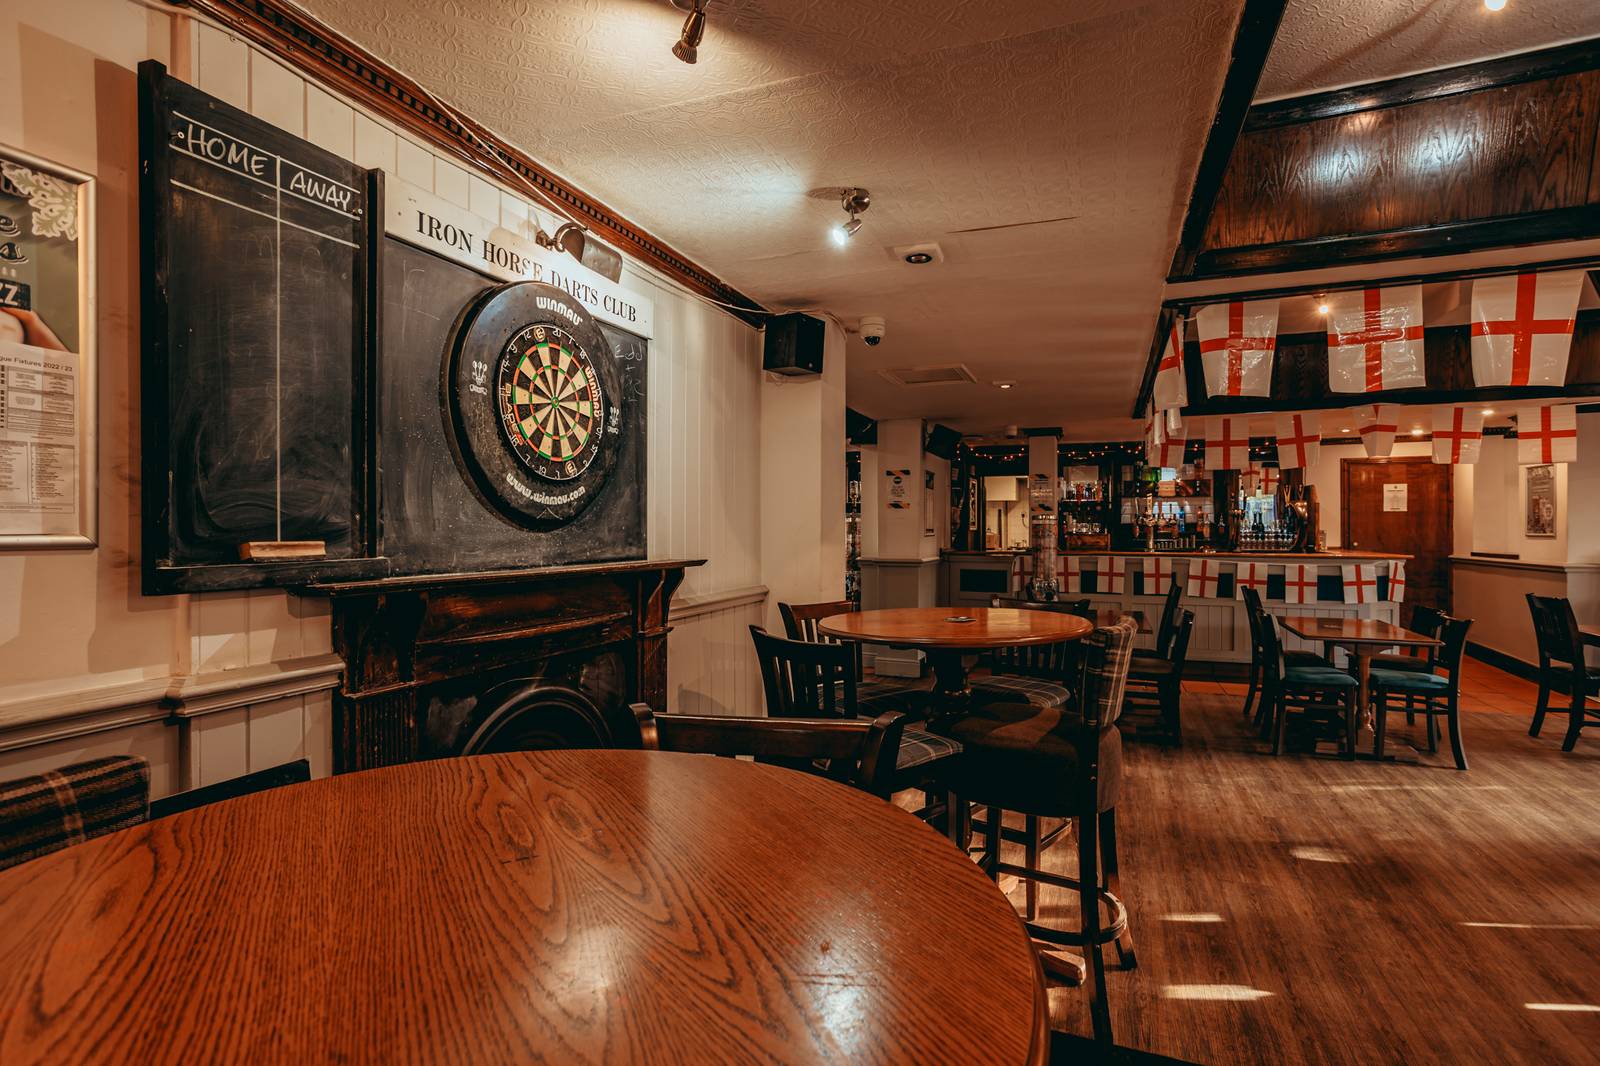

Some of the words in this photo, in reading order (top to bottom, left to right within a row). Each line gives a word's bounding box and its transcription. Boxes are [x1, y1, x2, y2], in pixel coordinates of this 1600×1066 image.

[187, 123, 269, 177] HOME
[289, 170, 352, 212] AWAY
[416, 210, 473, 254] IRON
[482, 239, 544, 282] HORSE
[551, 270, 598, 306] DARTS
[603, 295, 637, 323] CLUB
[14, 356, 42, 368] Fixtures
[43, 361, 60, 370] 2022
[505, 472, 587, 506] www.winmau.com
